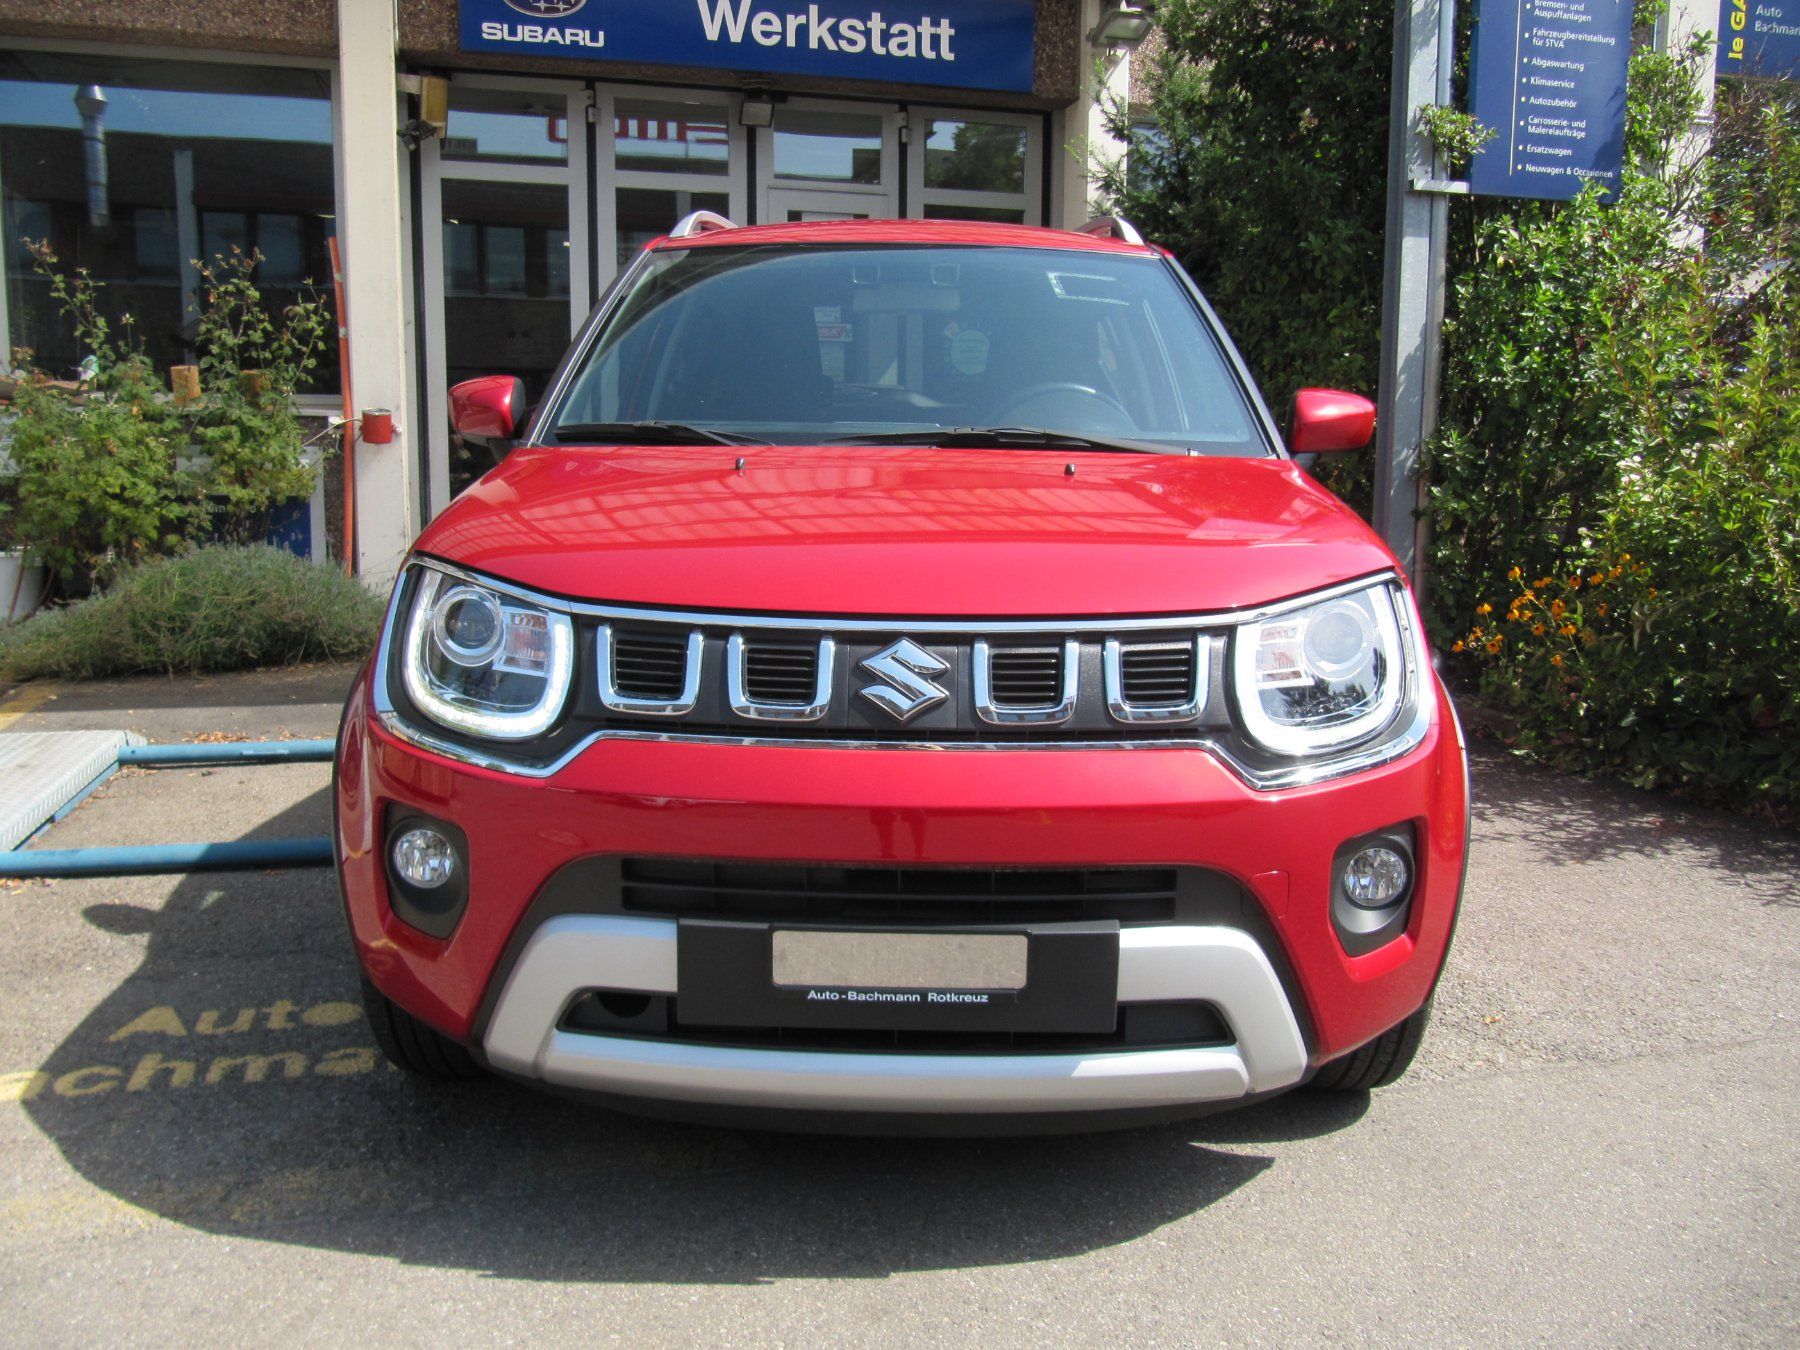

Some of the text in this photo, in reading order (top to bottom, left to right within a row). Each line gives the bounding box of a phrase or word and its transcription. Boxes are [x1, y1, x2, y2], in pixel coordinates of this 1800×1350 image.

[1570, 3, 1585, 12] und
[1756, 5, 1782, 18] Auto
[1534, 8, 1592, 22] Auspuffanlagen
[481, 22, 605, 48] SUBARU
[697, 0, 956, 61] Werkstatt
[1532, 28, 1615, 46] Fahrzeugbereitstellung
[1532, 37, 1564, 49] für STVA
[1531, 58, 1585, 72] Abgaswartung
[1530, 77, 1575, 88] Klimaservice
[1529, 96, 1577, 108] Autozubehör
[1528, 116, 1586, 129] Carrosserie- und
[1528, 126, 1586, 139] Malereiaufträge
[1526, 144, 1572, 156] Ersatzwagen
[1525, 164, 1613, 179] Neuwagen & Occasionen
[927, 992, 989, 1004] Rotkreuz
[107, 1000, 365, 1043] Auto
